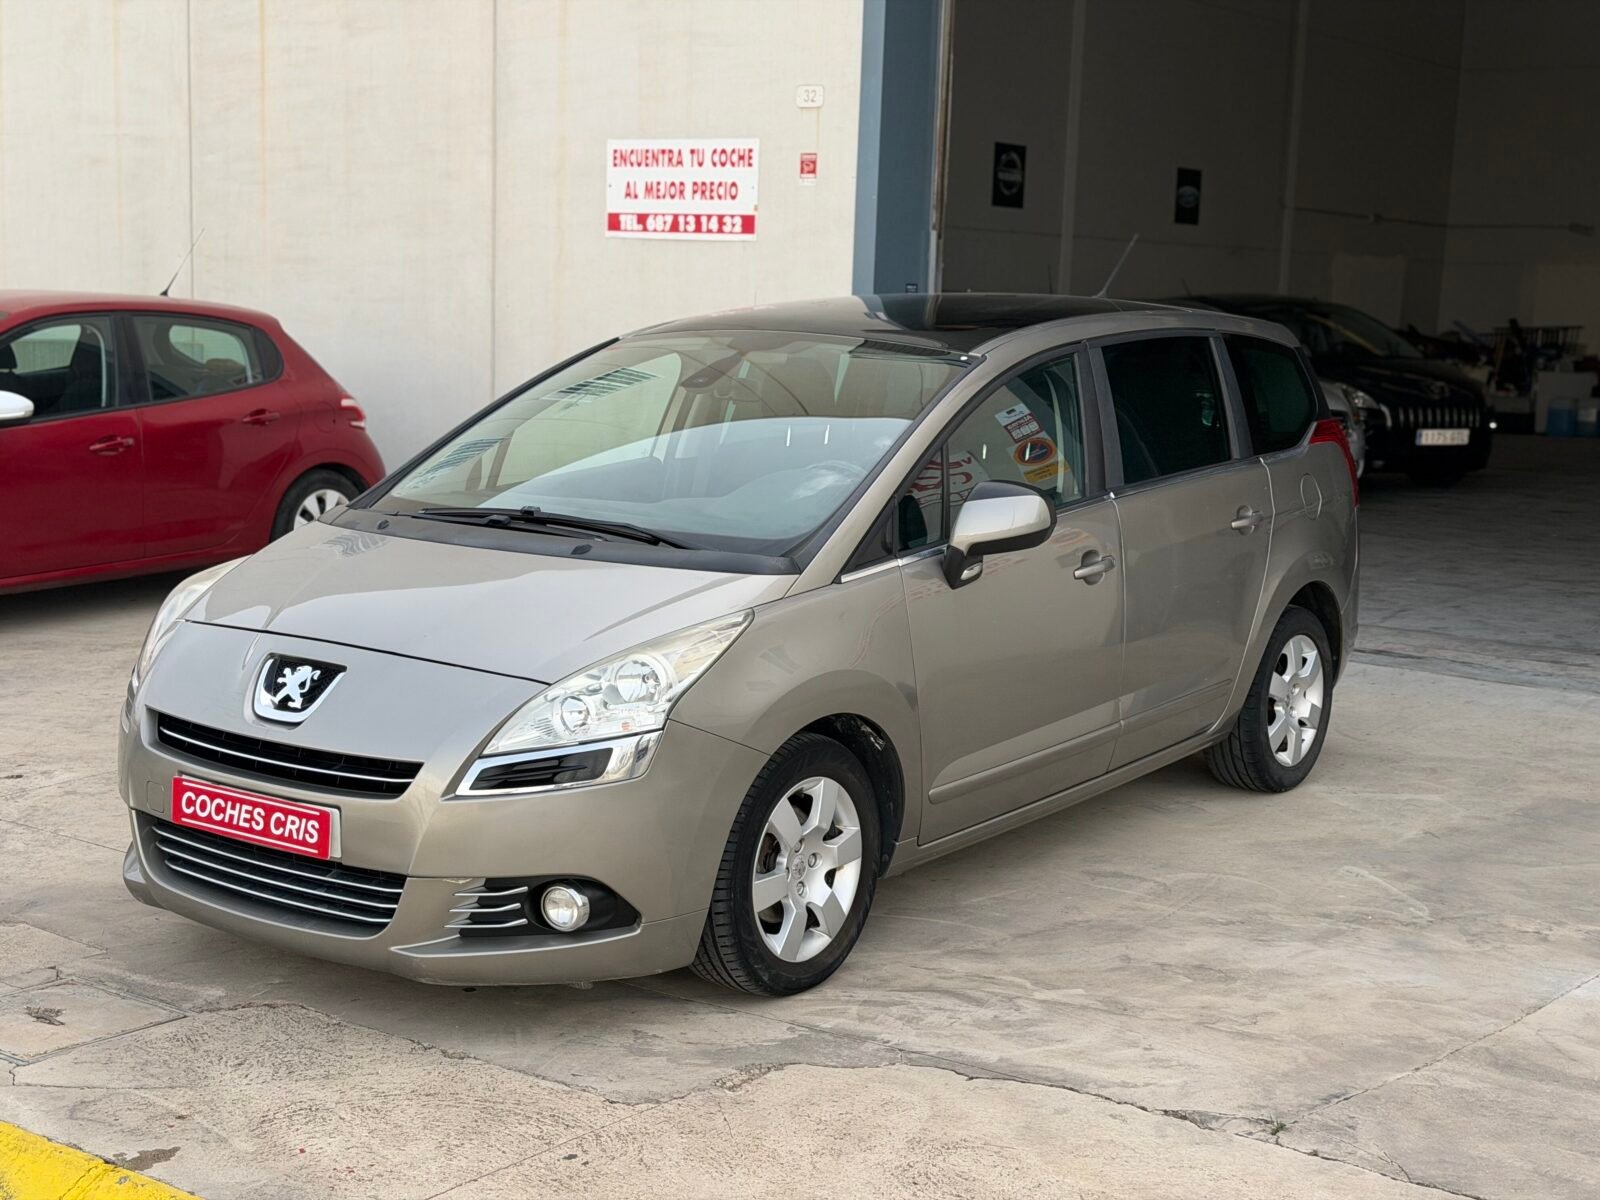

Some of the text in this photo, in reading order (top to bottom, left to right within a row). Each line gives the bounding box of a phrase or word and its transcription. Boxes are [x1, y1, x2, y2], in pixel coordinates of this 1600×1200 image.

[803, 89, 817, 103] 32
[612, 148, 754, 168] ENCUENTRA TU COCHE
[624, 180, 739, 201] AL MEJOR PRECIO
[618, 214, 743, 234] TEL. 687 13 14 32
[181, 791, 320, 844] COCHES CRIS
